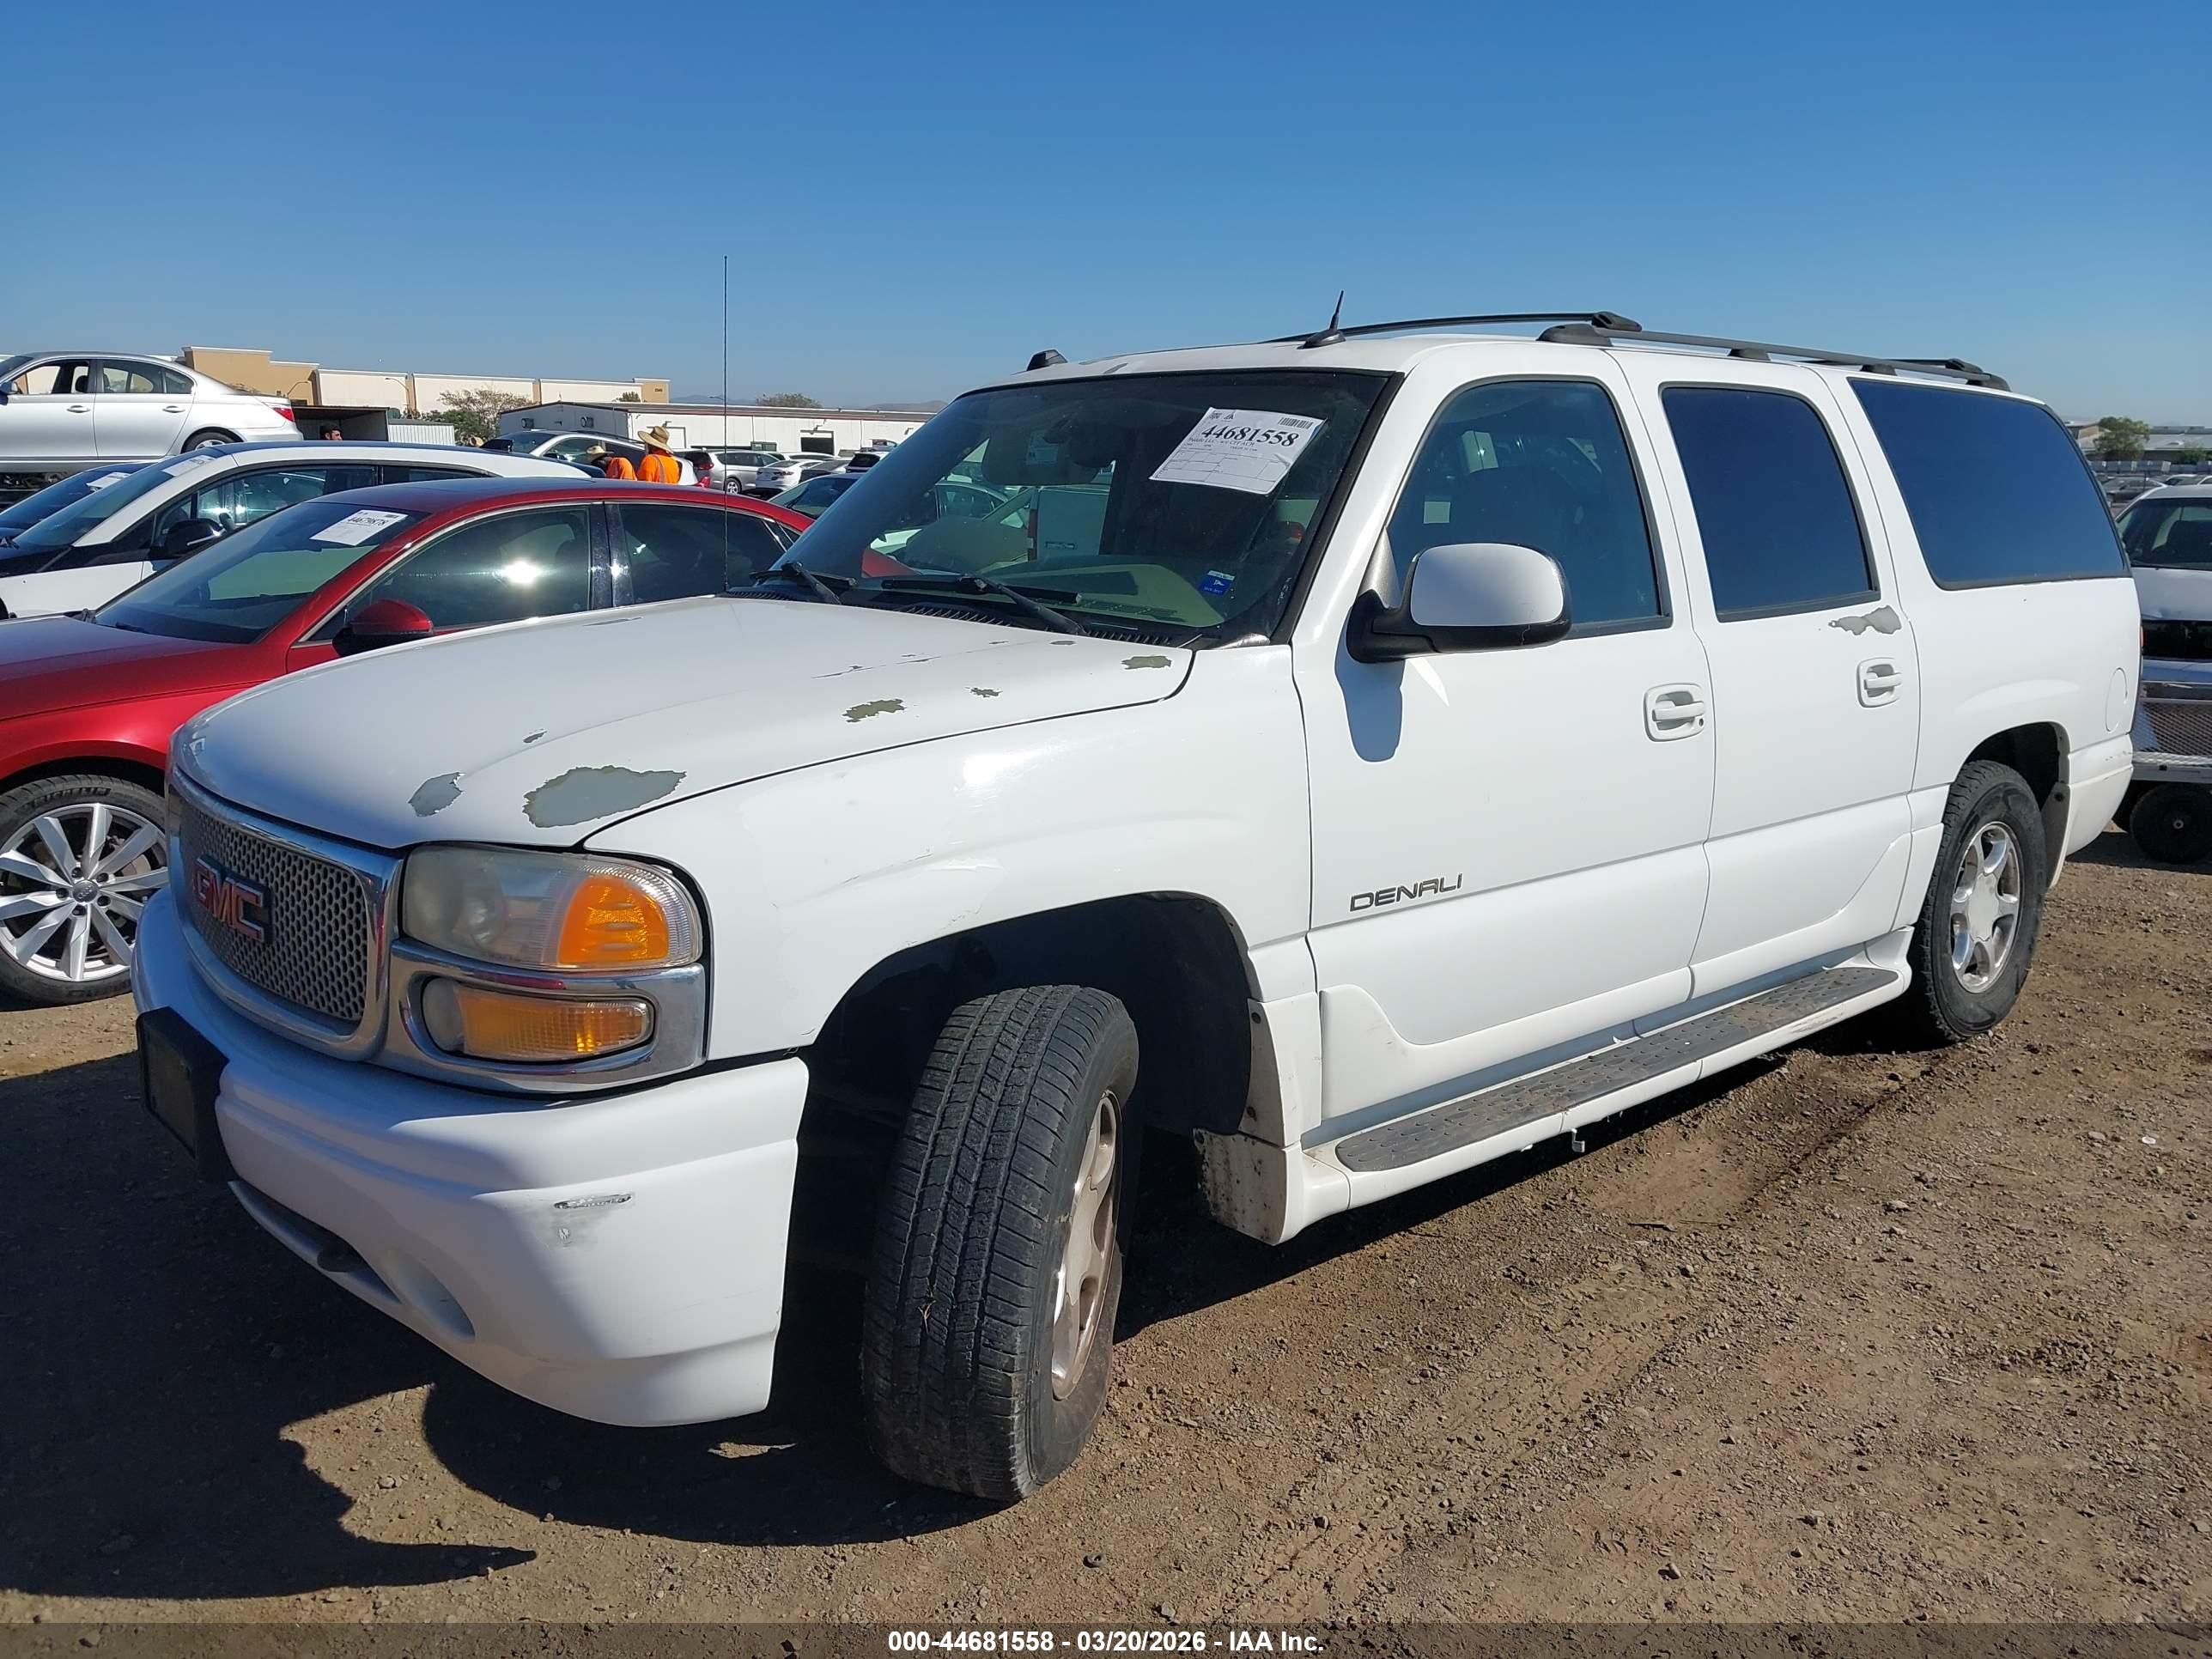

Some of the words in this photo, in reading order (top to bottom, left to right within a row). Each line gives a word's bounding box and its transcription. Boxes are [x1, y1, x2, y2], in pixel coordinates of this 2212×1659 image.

[1201, 424, 1299, 447] 44681558
[191, 857, 264, 942] GMC
[1350, 872, 1463, 912] DENALI
